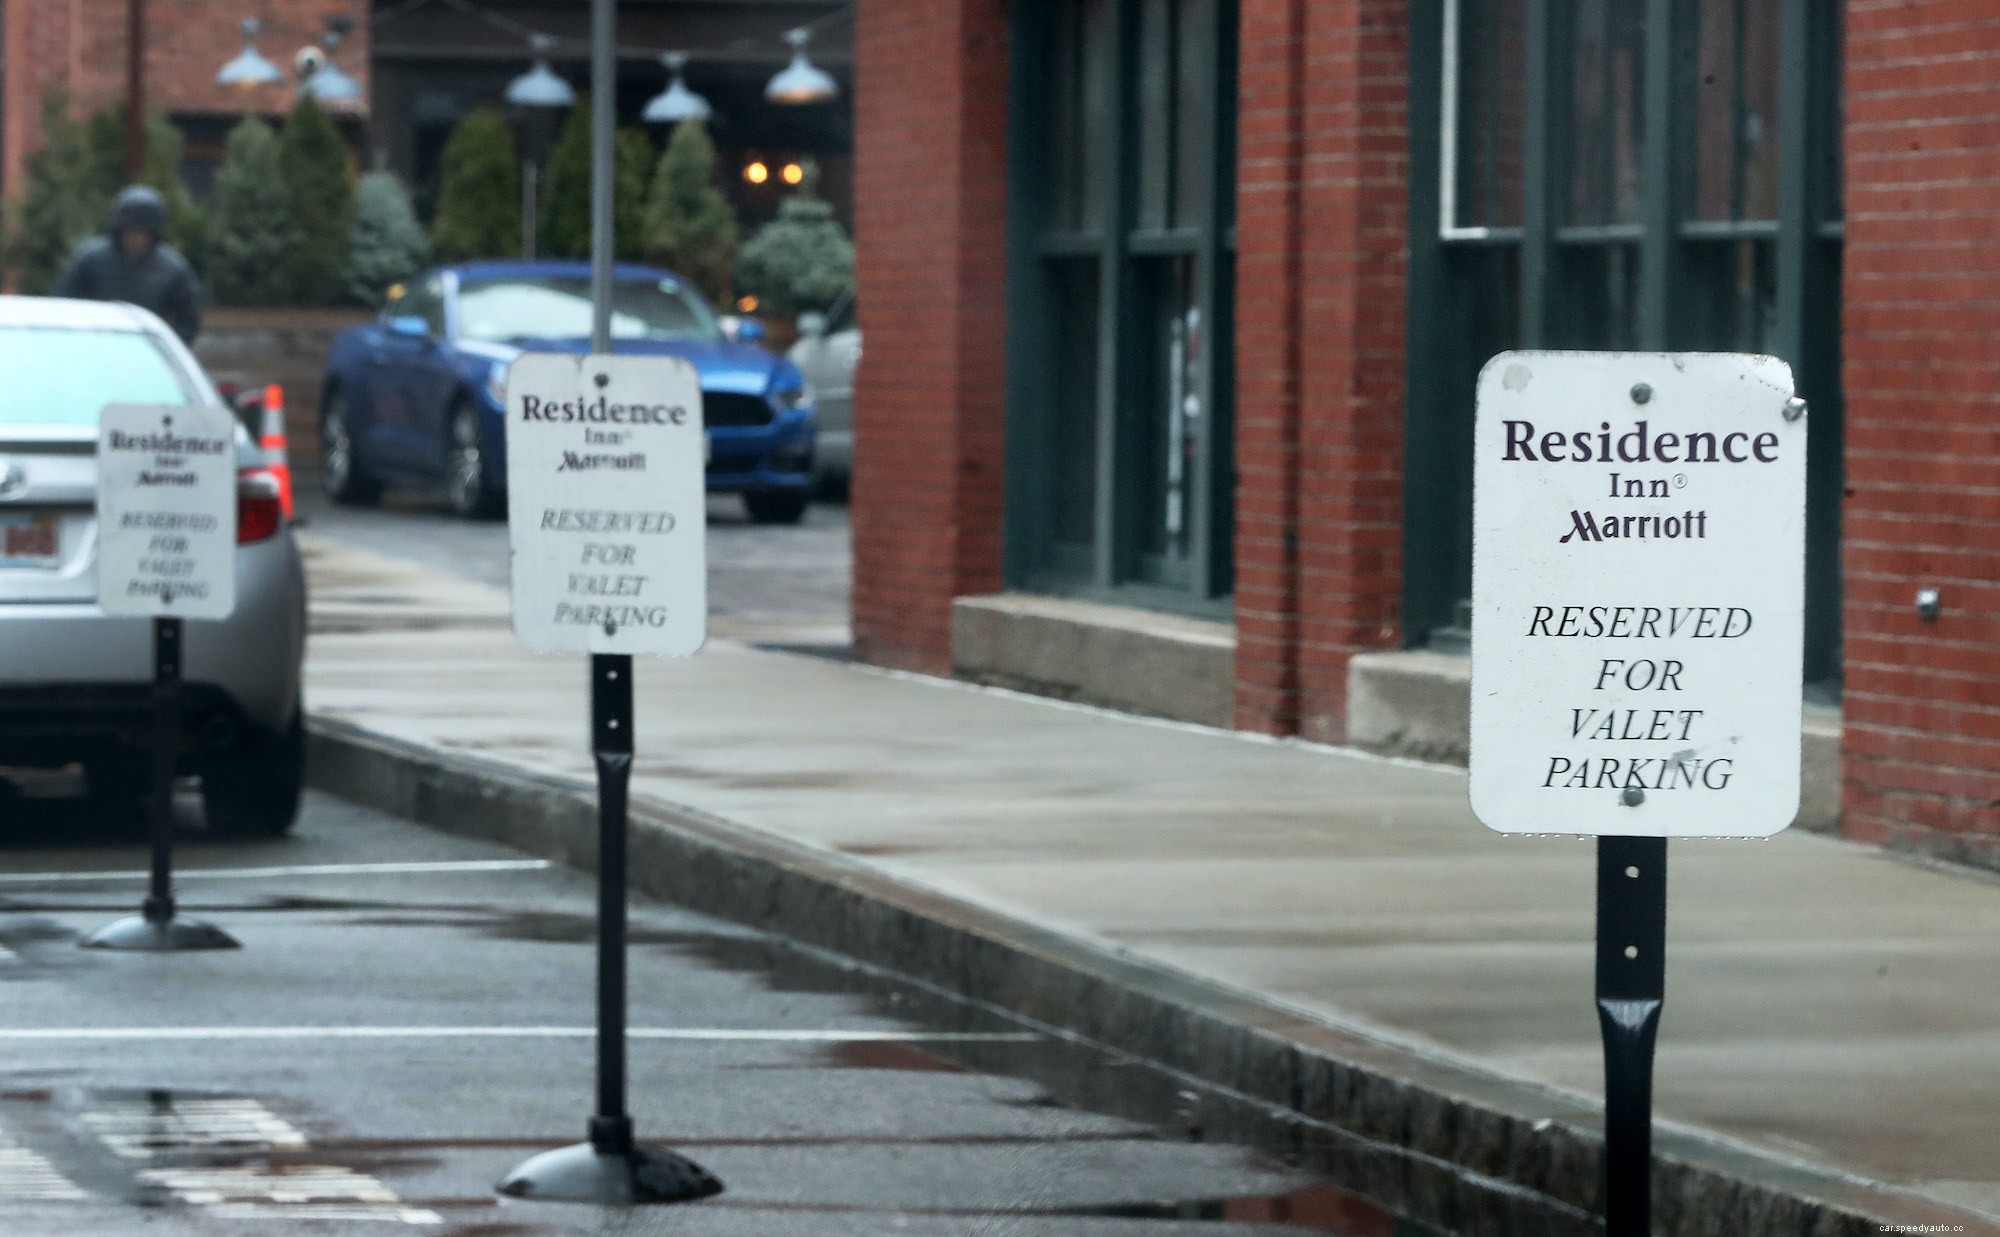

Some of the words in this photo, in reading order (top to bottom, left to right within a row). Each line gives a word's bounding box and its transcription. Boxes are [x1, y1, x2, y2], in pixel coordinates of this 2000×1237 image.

[521, 394, 687, 425] Residence
[1502, 420, 1780, 463] Residence
[540, 508, 676, 534] RESERVED
[1559, 509, 1707, 544] Marriott
[581, 543, 636, 566] FOR
[567, 573, 648, 597] VALET
[553, 602, 667, 628] PARKING
[1525, 606, 1752, 638] RESERVED
[1593, 659, 1684, 691] FOR
[1570, 708, 1703, 741] VALET
[1541, 757, 1733, 790] PARKING
